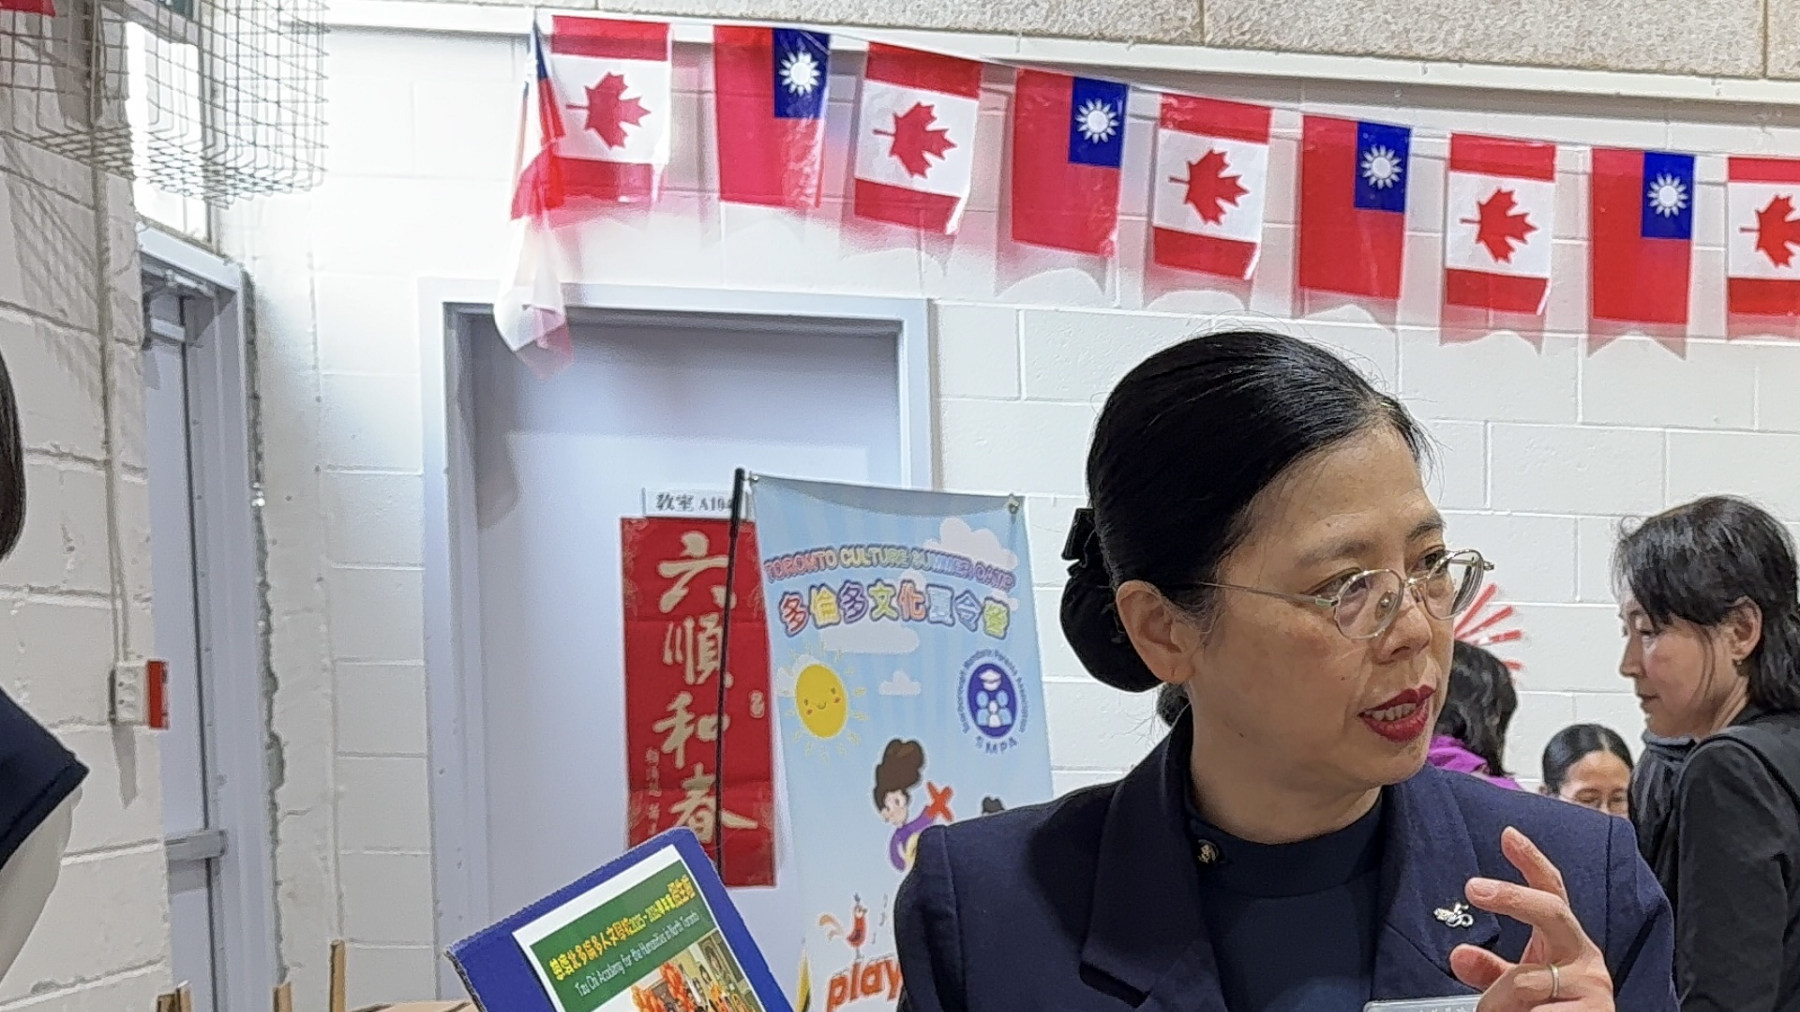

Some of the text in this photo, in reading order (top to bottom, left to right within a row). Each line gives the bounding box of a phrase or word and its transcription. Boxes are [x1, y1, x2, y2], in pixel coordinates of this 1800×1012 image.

[656, 492, 694, 512] 教室
[764, 546, 838, 583] TORONTO
[839, 543, 910, 570] CULTURE
